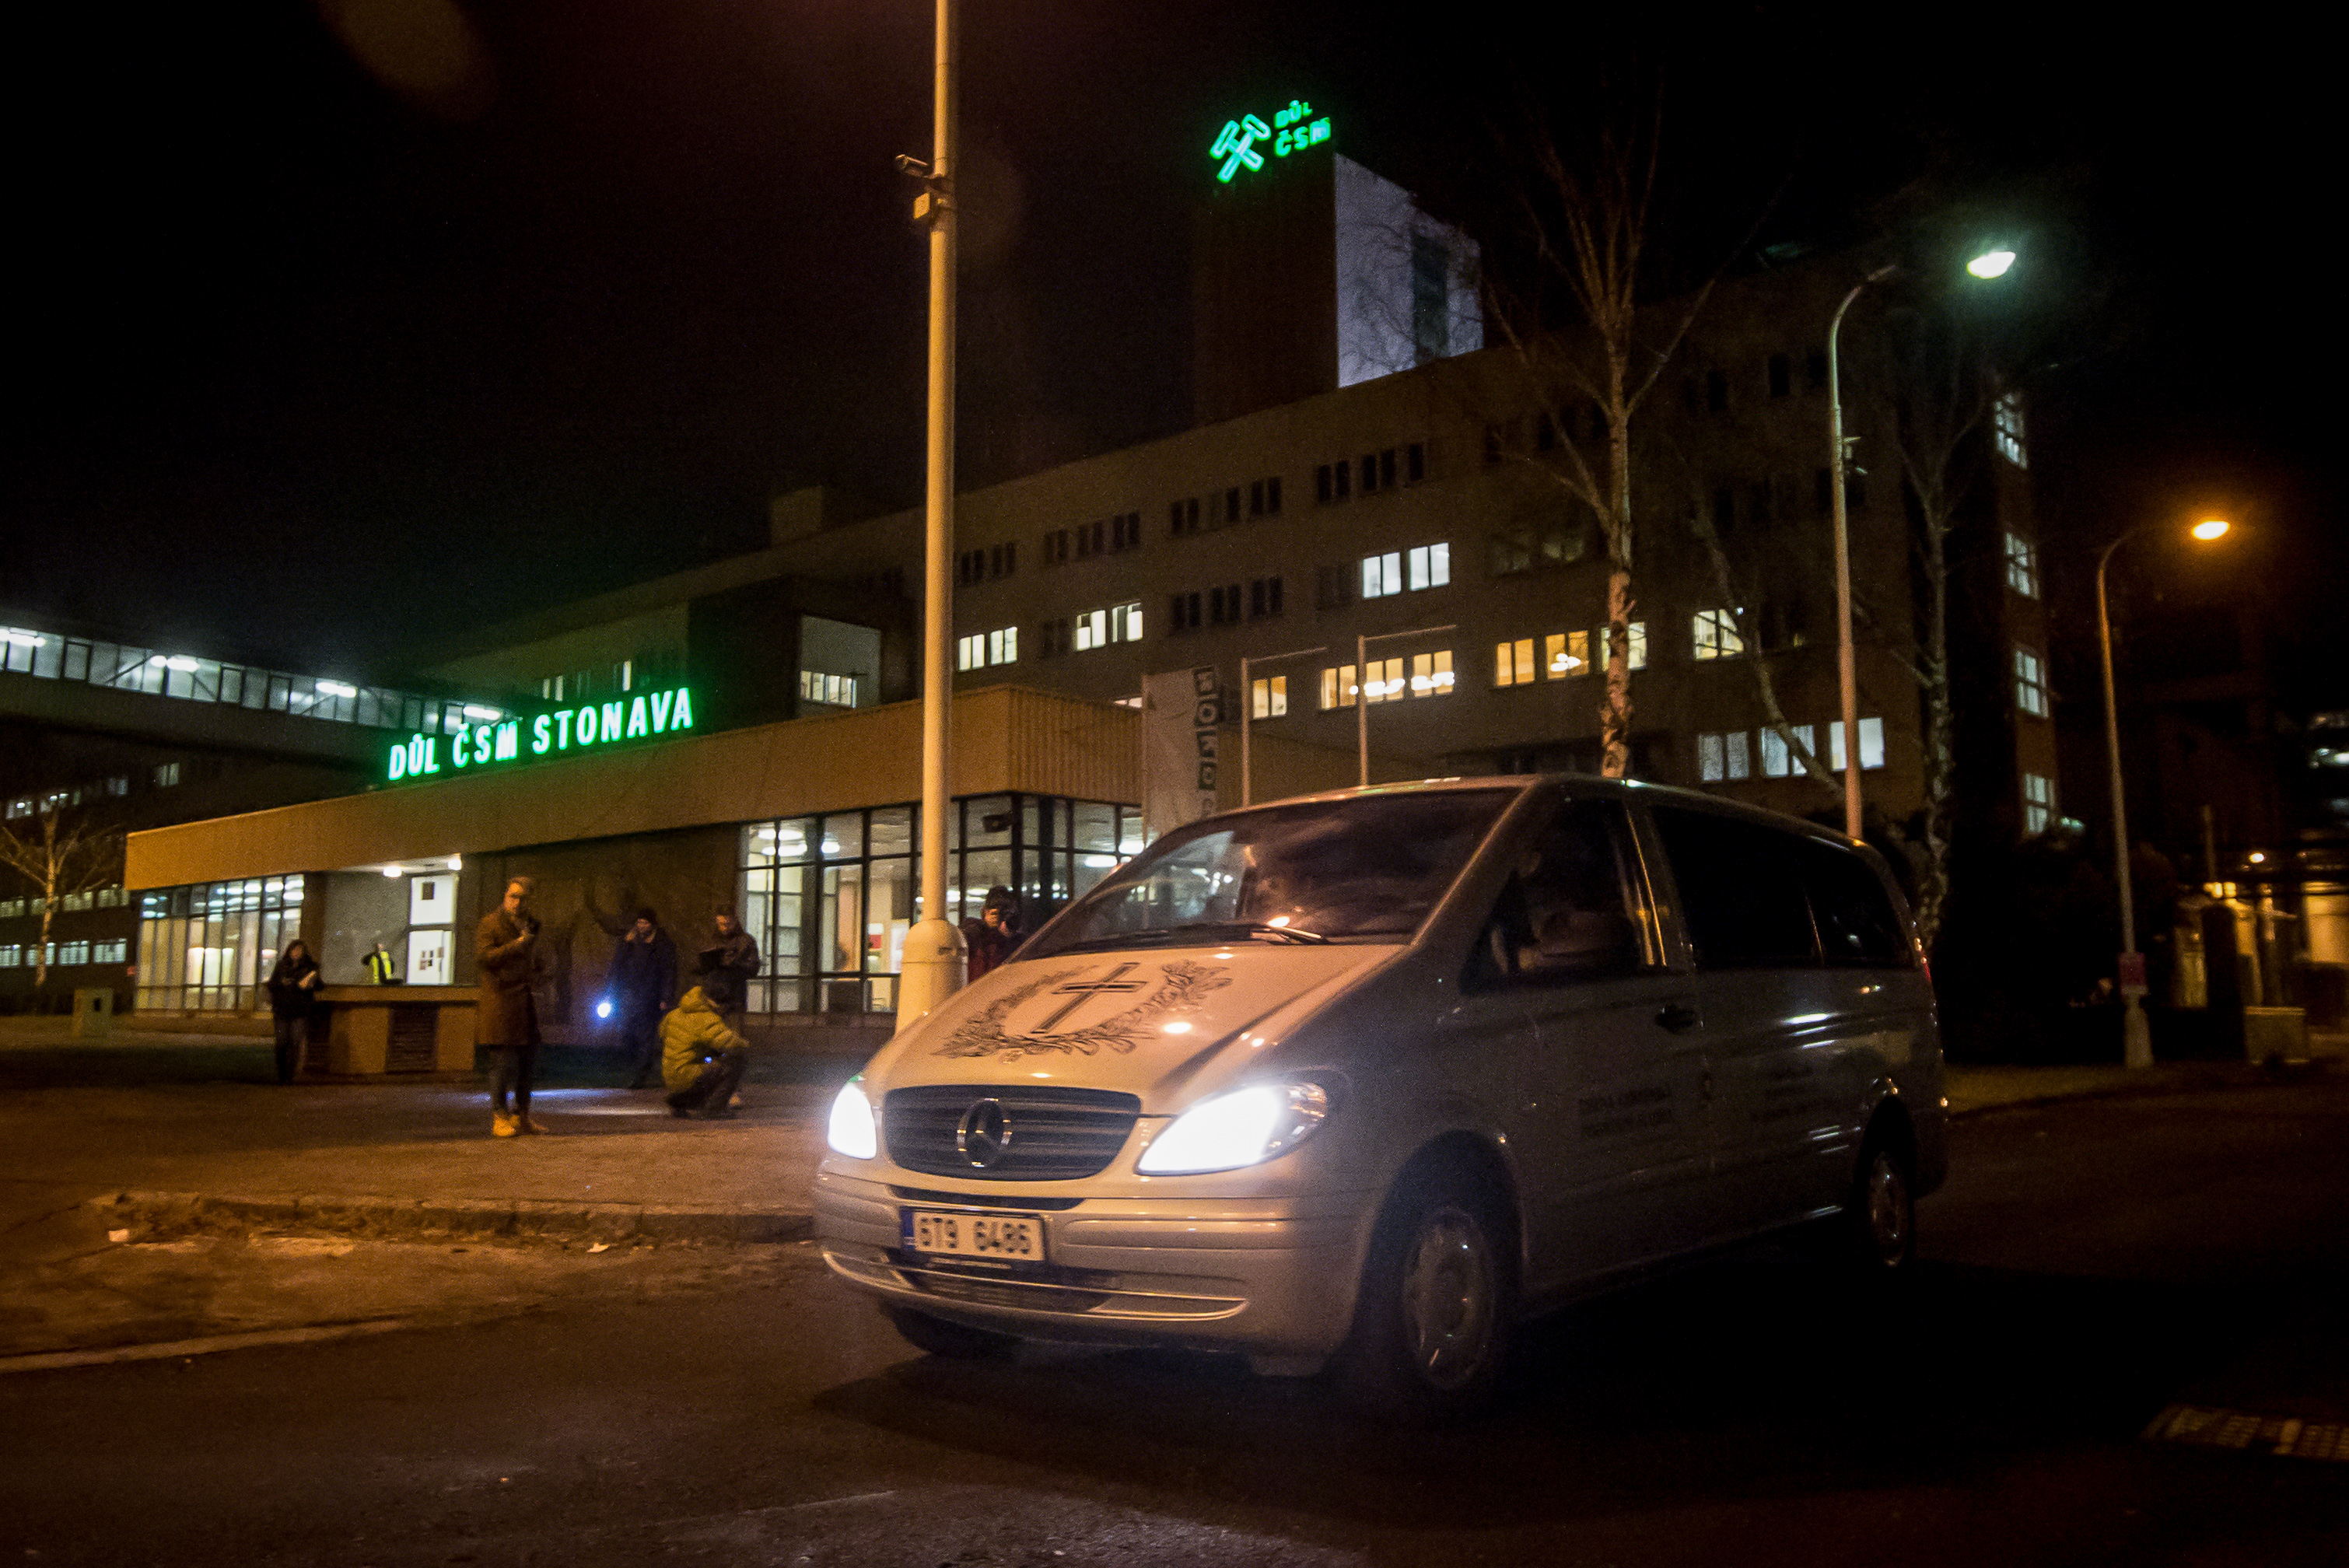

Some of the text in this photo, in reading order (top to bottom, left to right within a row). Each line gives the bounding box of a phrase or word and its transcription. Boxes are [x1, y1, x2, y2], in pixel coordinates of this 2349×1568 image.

[1274, 117, 1332, 157] ČSM
[389, 688, 693, 780] DŮL ČSM STONAVA
[918, 1216, 958, 1248] 6T9
